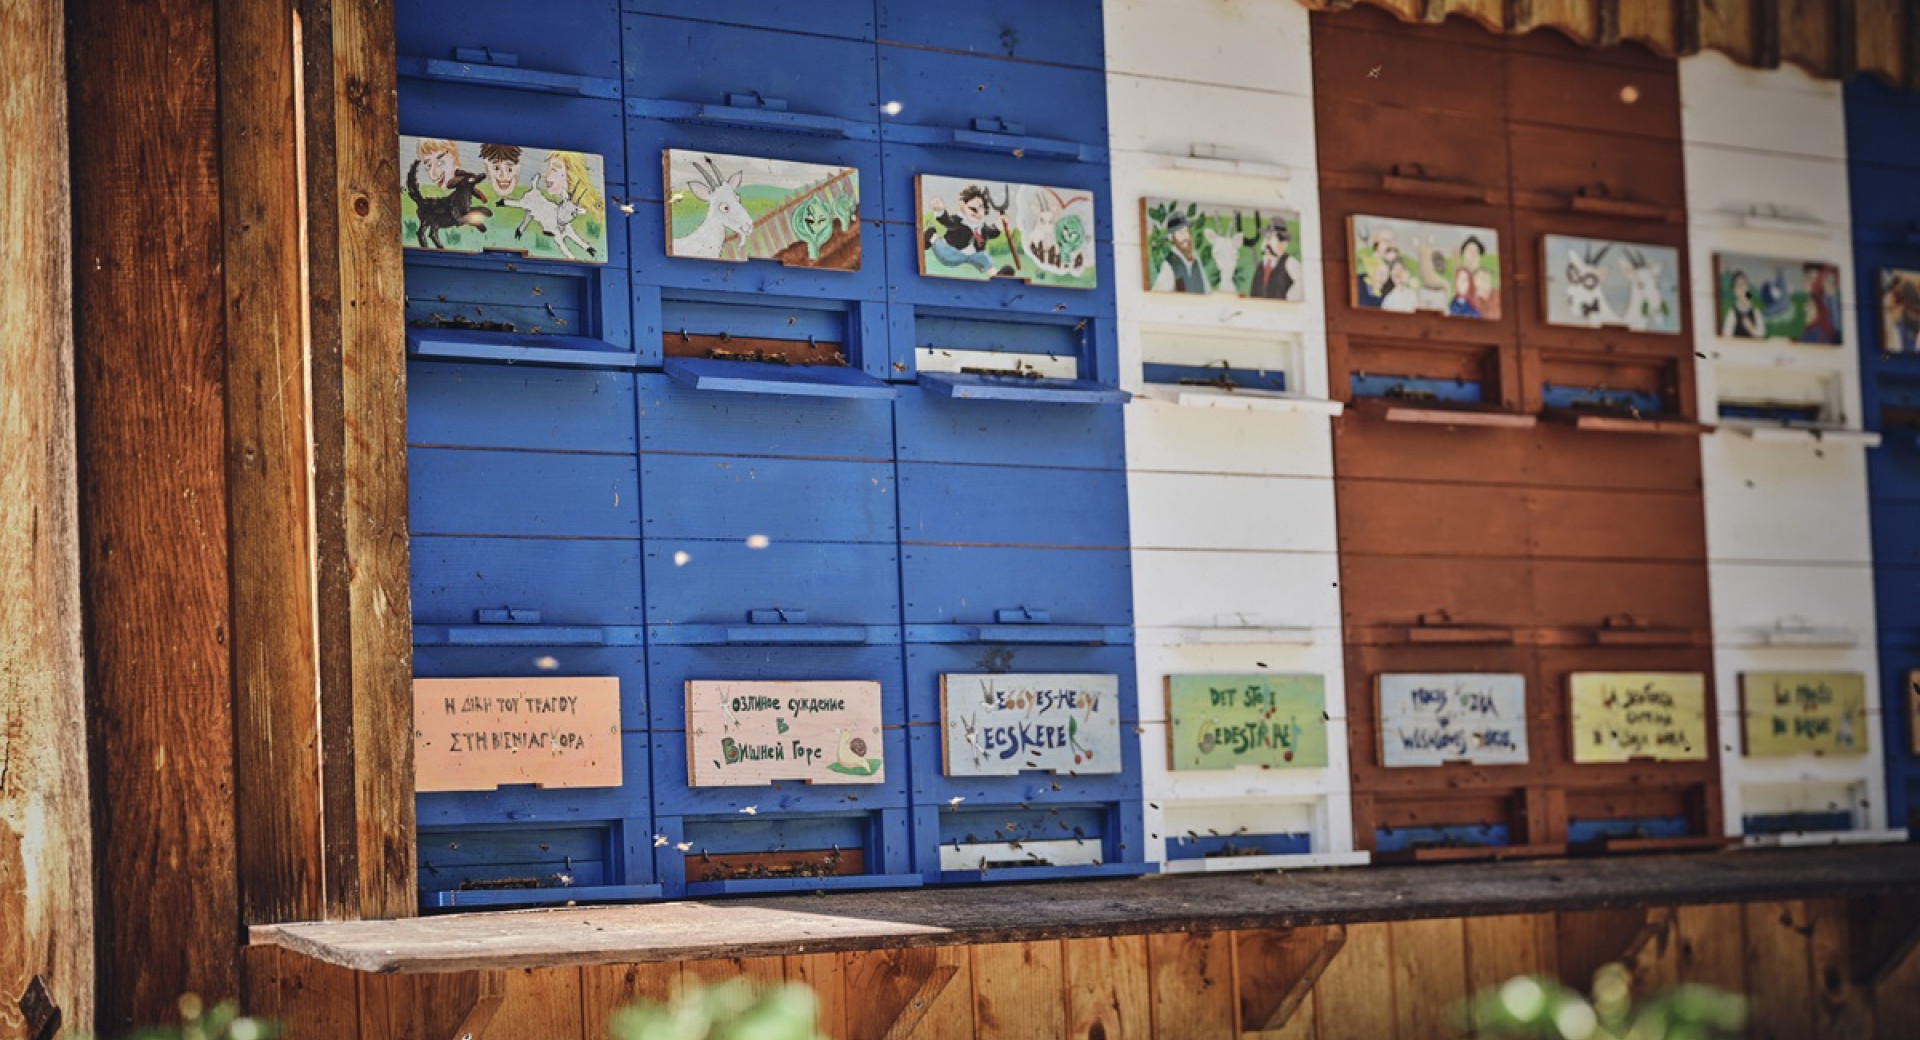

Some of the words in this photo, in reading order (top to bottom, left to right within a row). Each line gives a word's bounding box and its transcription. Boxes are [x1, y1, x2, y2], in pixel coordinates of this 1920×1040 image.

[496, 697, 519, 714] ΤΟΥ
[1209, 687, 1237, 707] DET
[450, 732, 488, 752] ΣΤΗ
